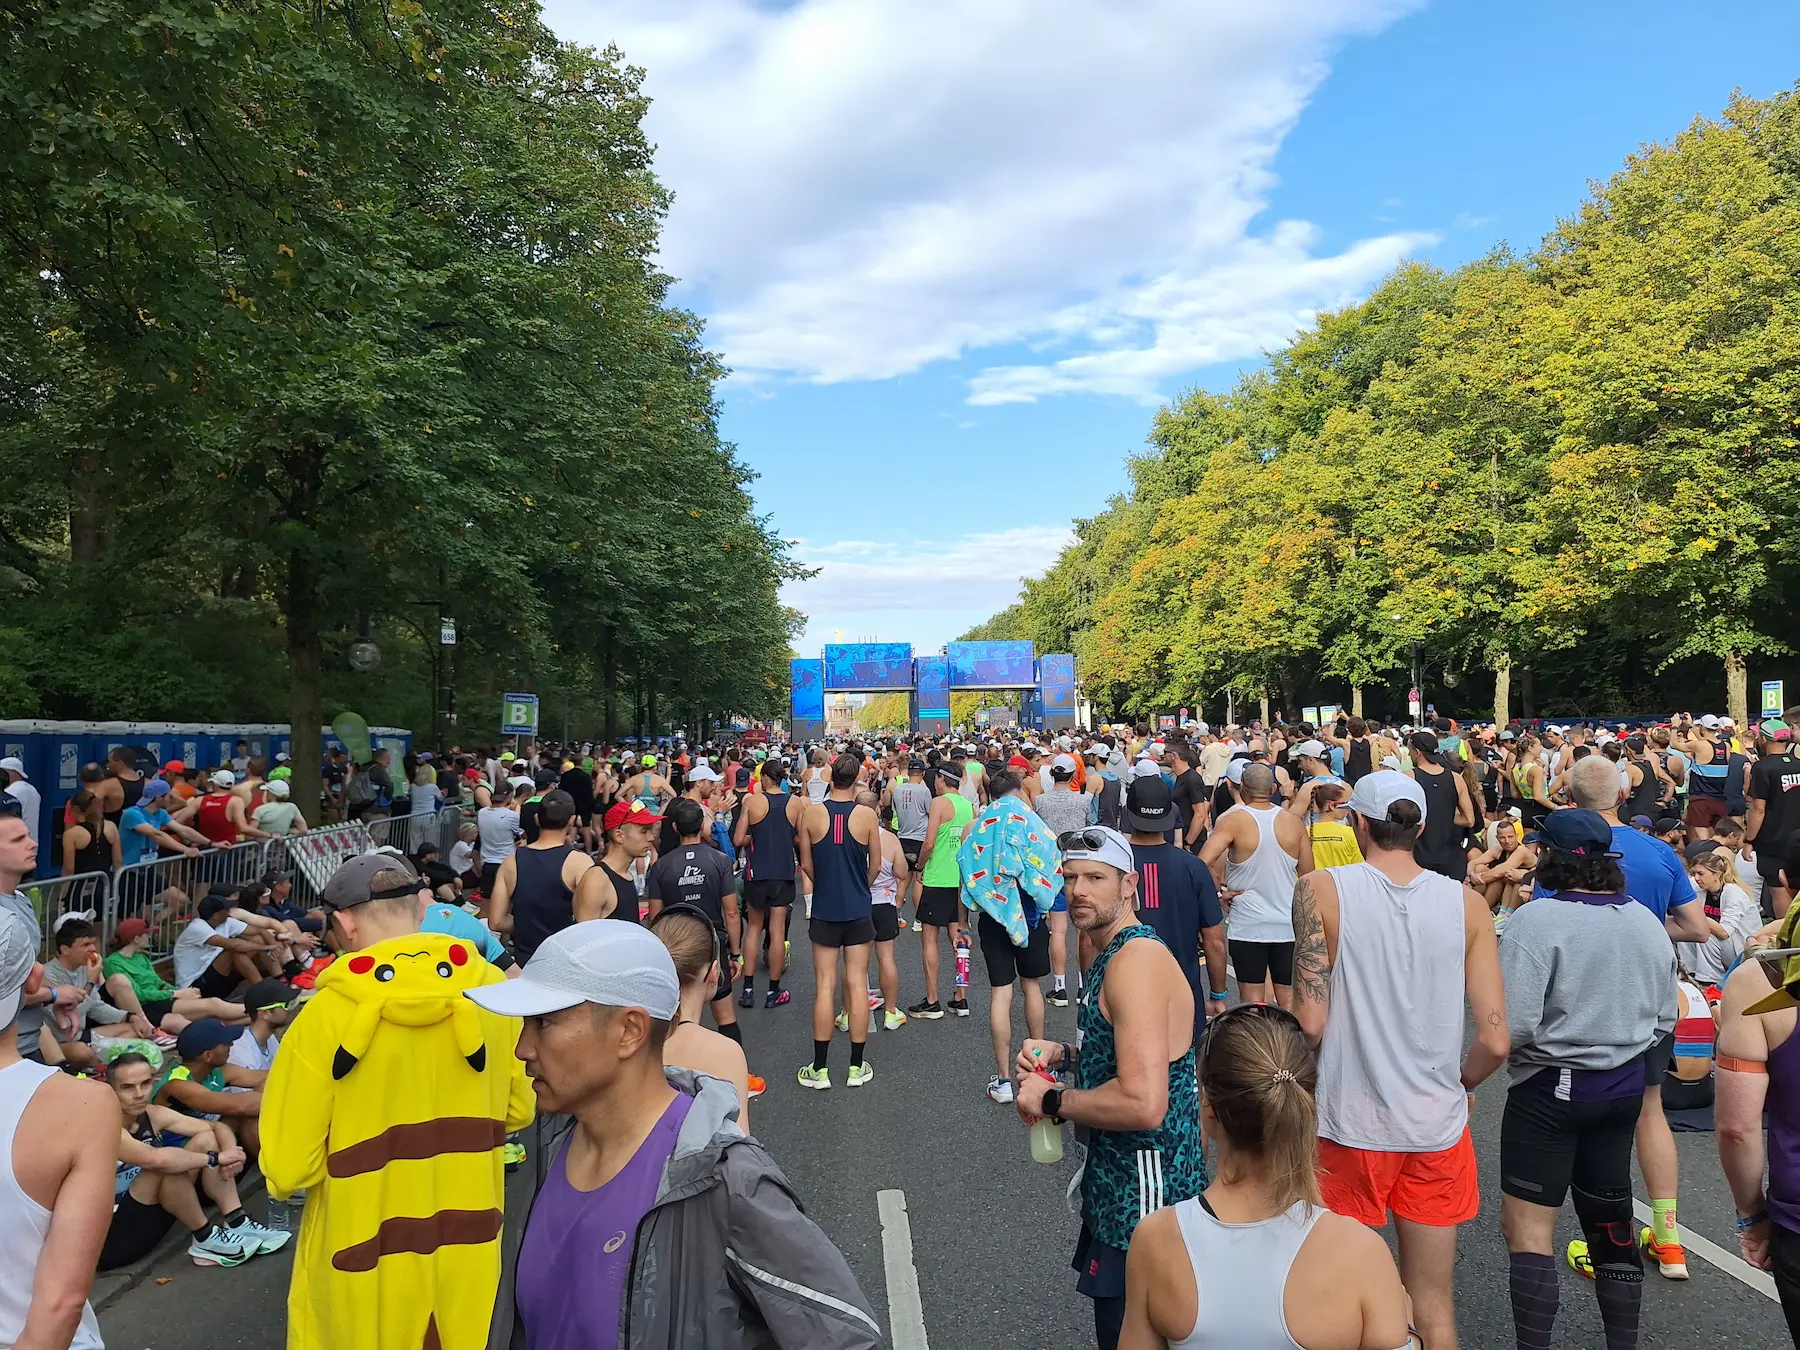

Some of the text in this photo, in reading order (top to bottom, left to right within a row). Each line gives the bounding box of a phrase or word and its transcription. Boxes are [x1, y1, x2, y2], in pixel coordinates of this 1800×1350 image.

[443, 633, 455, 641] 658
[1766, 690, 1777, 708] B
[511, 703, 528, 725] B
[1140, 807, 1165, 815] BANDIT
[678, 874, 706, 886] RUNNERS
[684, 893, 701, 902] JUAN
